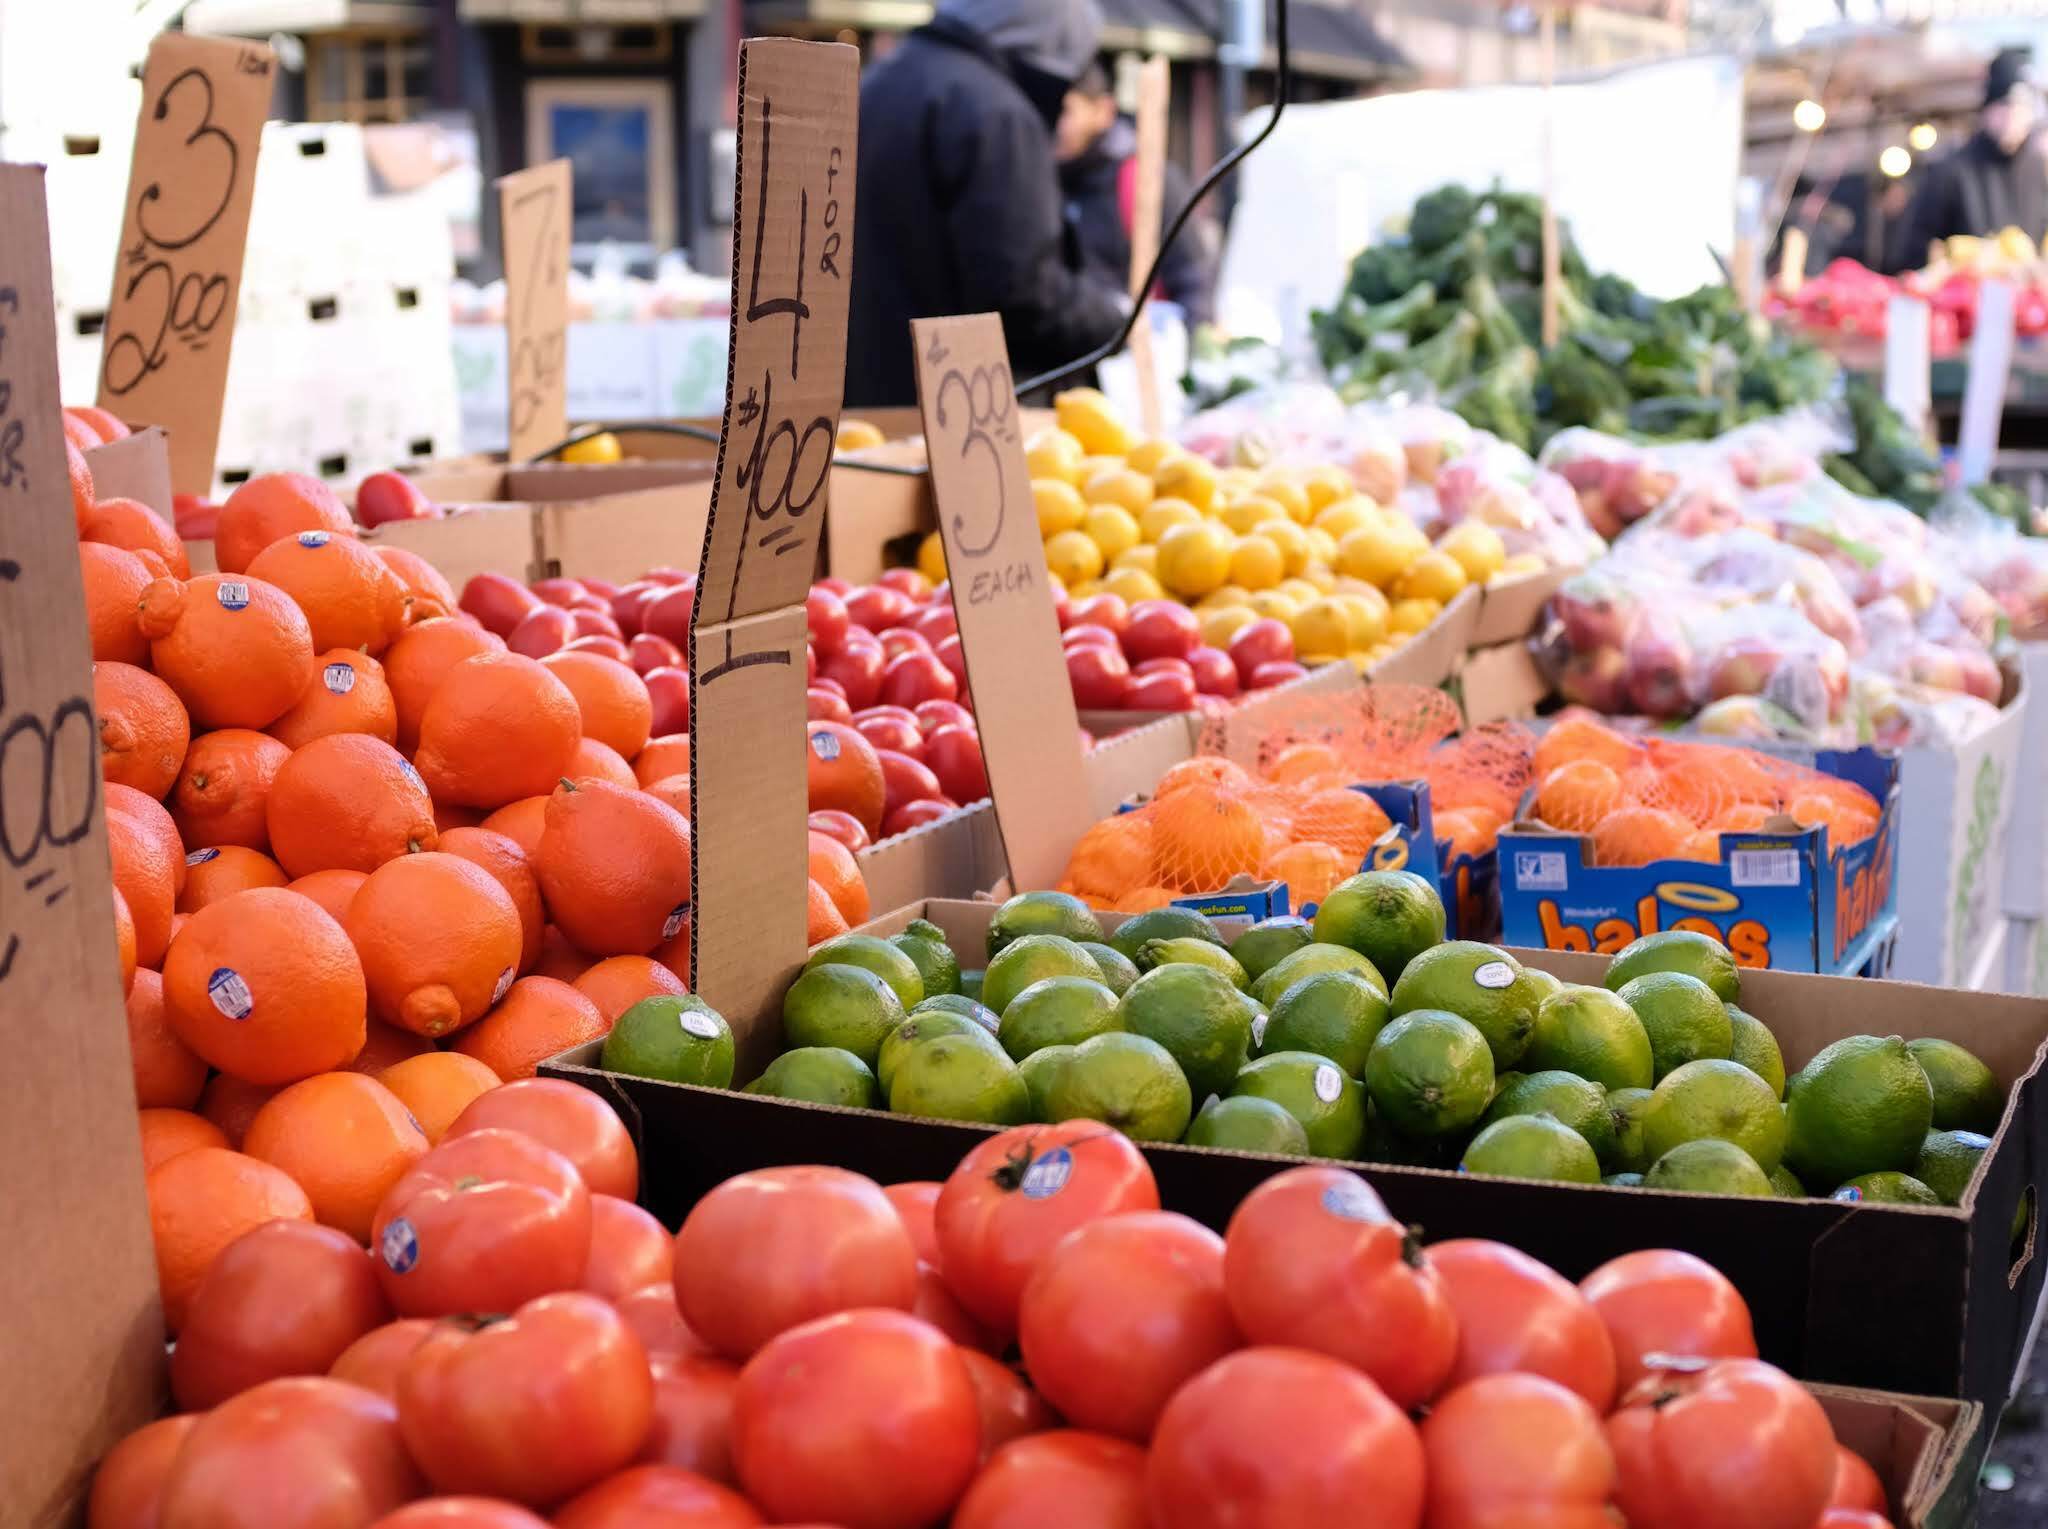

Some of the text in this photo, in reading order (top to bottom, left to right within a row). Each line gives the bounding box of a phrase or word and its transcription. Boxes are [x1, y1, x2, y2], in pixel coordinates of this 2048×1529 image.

[136, 68, 238, 251] 3
[747, 95, 810, 382] 4
[968, 562, 1034, 606] EACH
